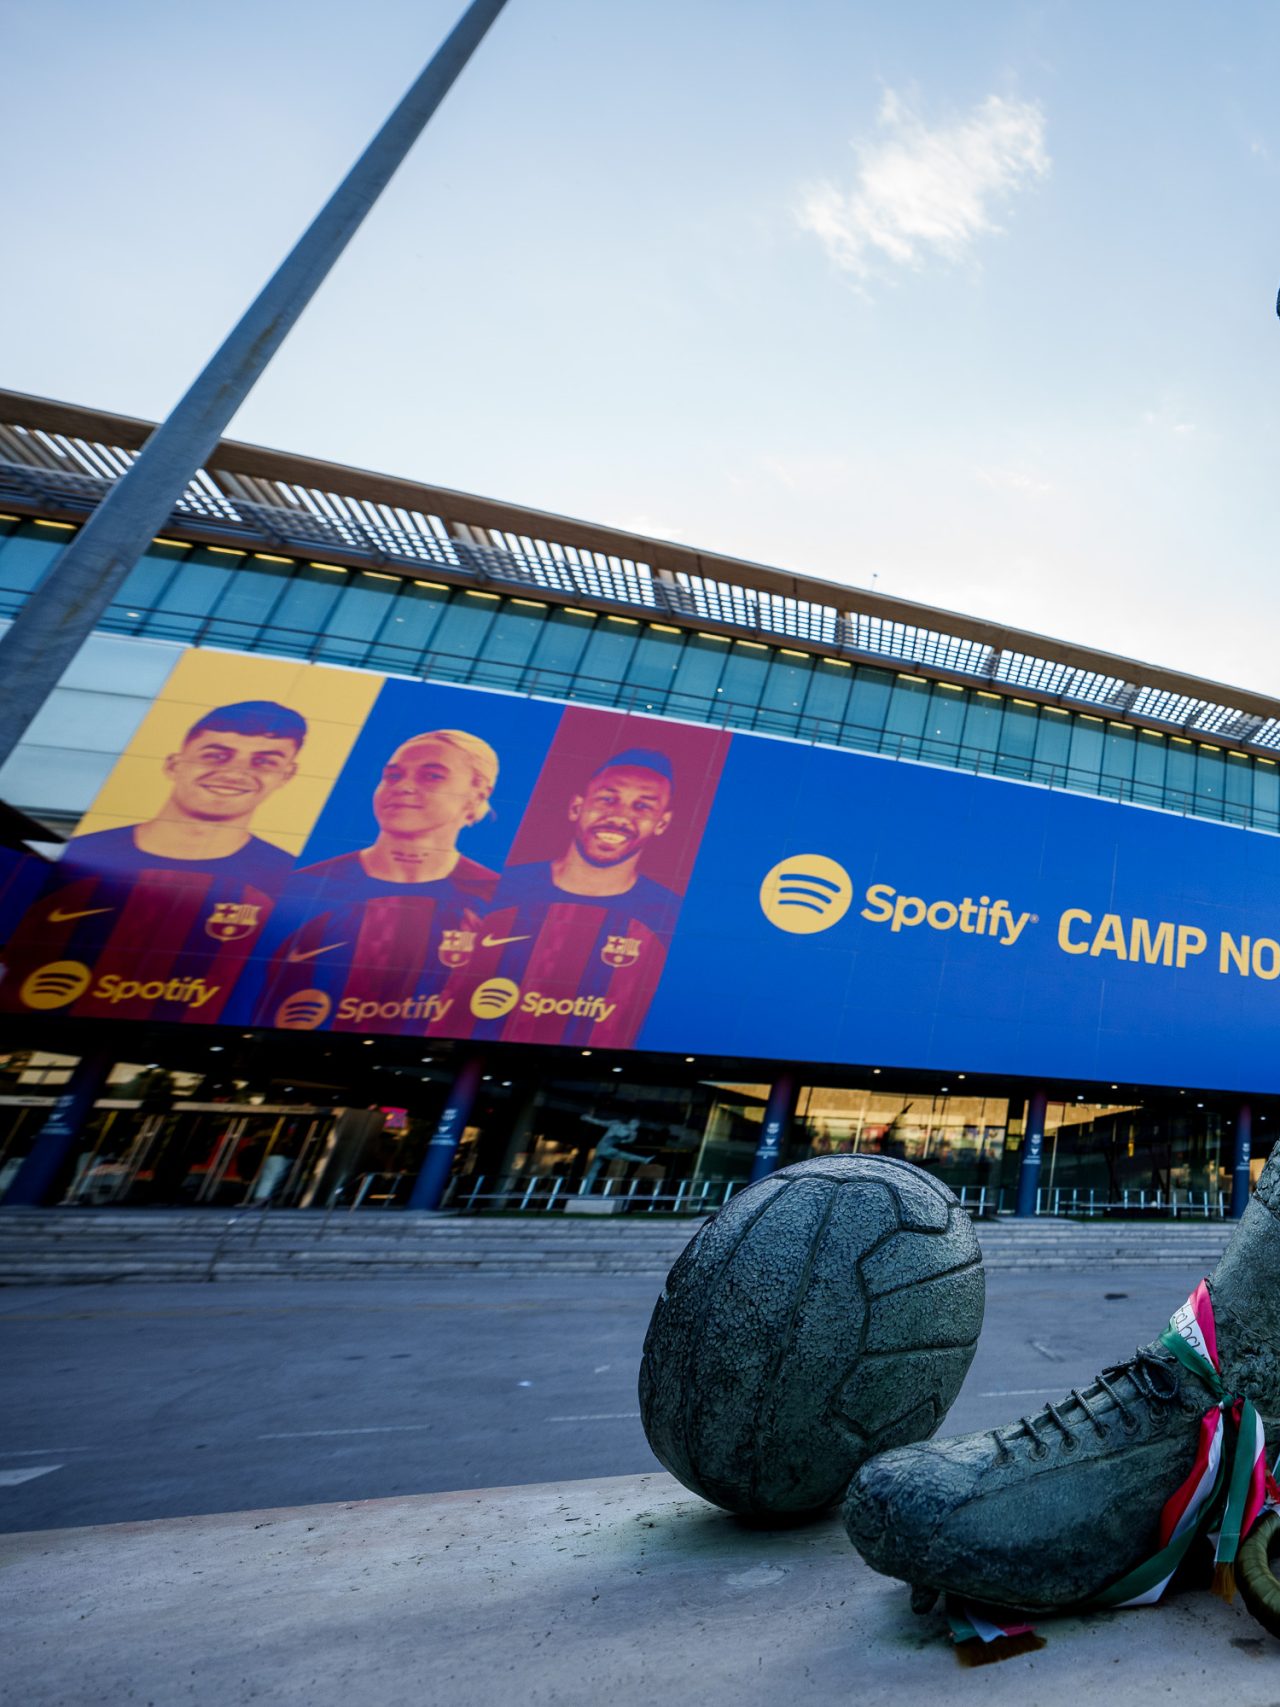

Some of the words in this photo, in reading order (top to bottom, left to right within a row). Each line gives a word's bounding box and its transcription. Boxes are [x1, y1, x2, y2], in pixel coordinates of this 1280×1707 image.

[1057, 908, 1207, 968] CAMP
[92, 973, 220, 1008] Spotify
[519, 991, 617, 1023] Spotify
[335, 993, 455, 1023] Spotify
